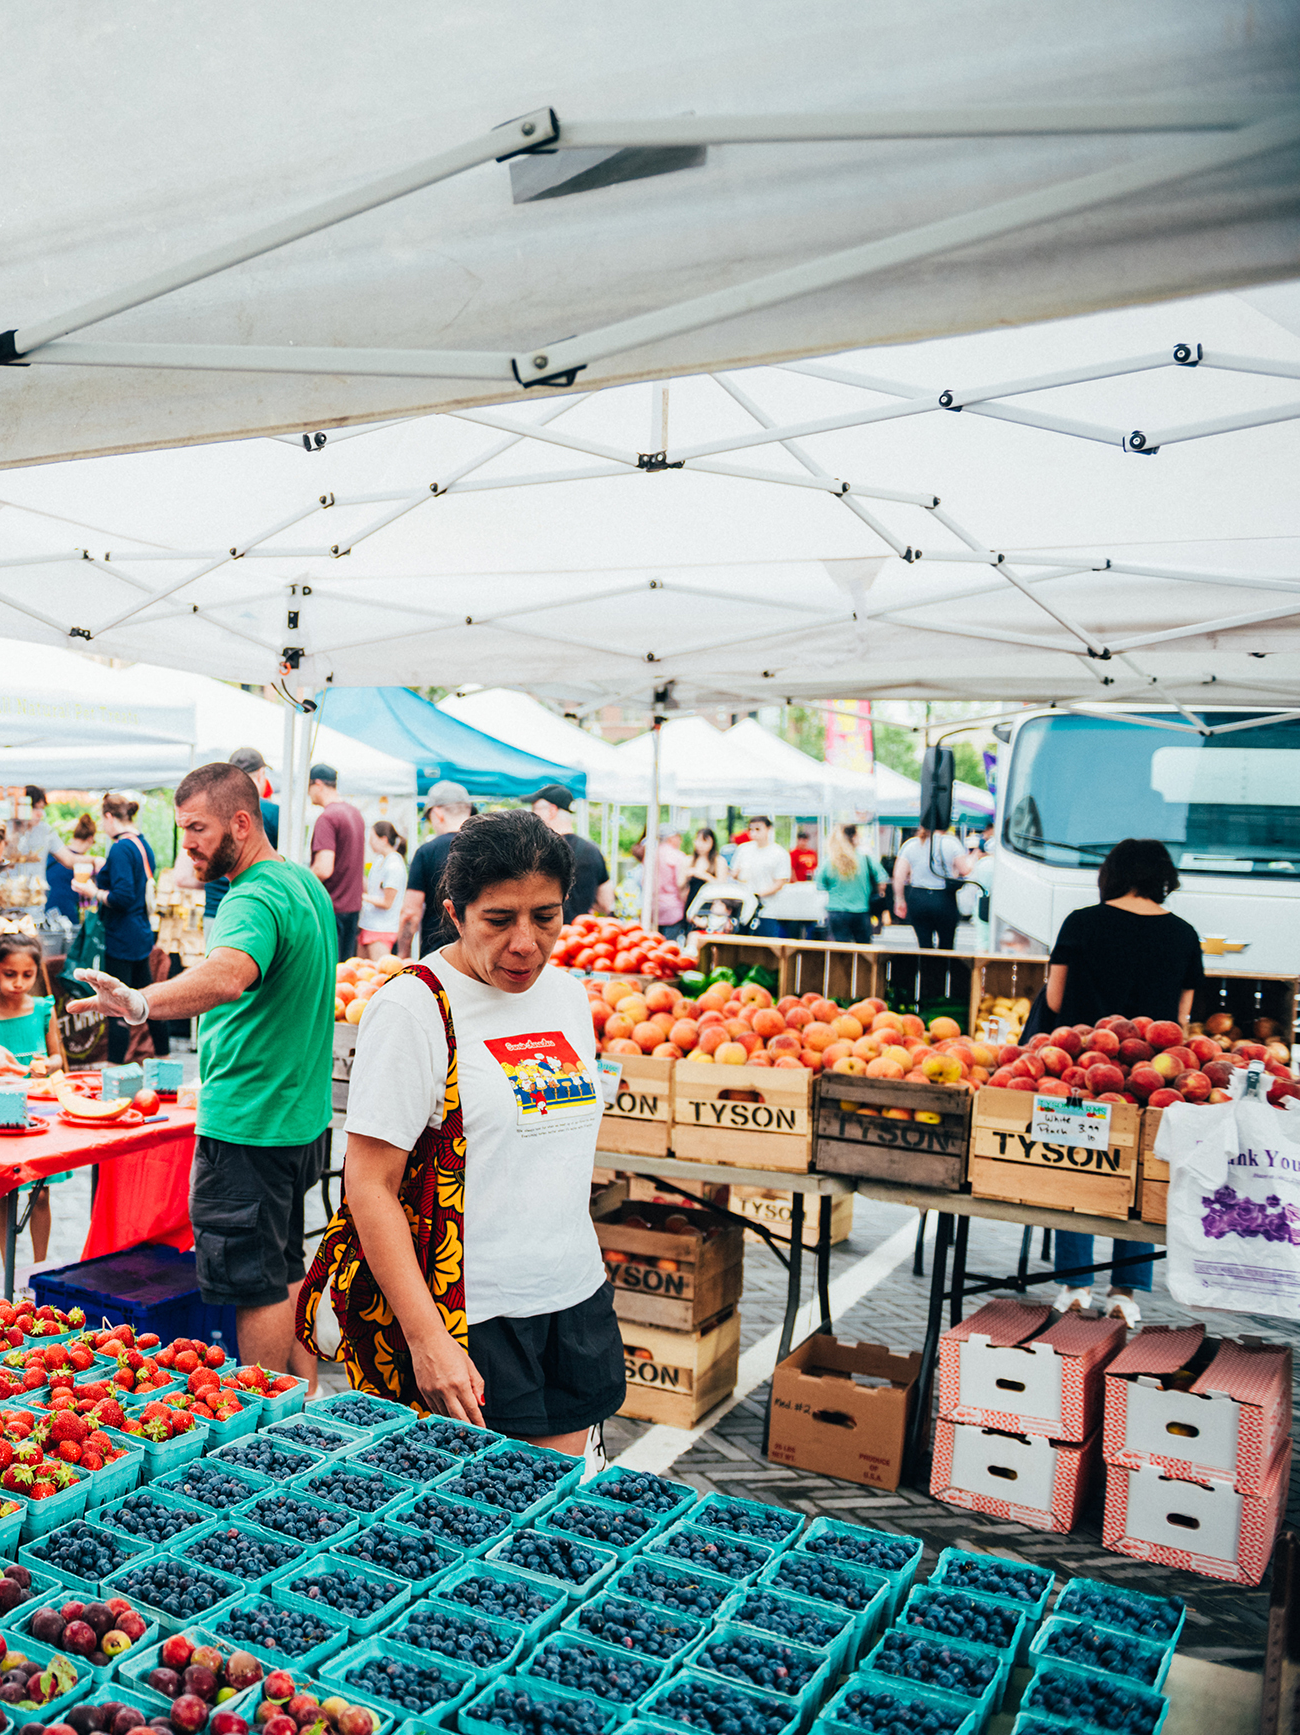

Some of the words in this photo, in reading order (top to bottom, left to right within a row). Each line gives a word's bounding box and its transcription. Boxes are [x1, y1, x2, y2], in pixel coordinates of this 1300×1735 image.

[17, 698, 70, 719] Natural
[75, 703, 95, 721] Pet
[99, 705, 139, 725] Treats
[689, 1101, 796, 1130] TYSON
[1040, 1099, 1070, 1109] TYSON
[835, 1112, 950, 1151] TYSON
[1045, 1114, 1071, 1124] White
[993, 1131, 1121, 1172] TYSON
[1264, 1149, 1300, 1172] You
[739, 1199, 807, 1222] TYSO
[606, 1262, 684, 1295] YSON
[626, 1358, 679, 1387] SON
[859, 1453, 890, 1466] PRODUCE
[869, 1464, 878, 1472] OF
